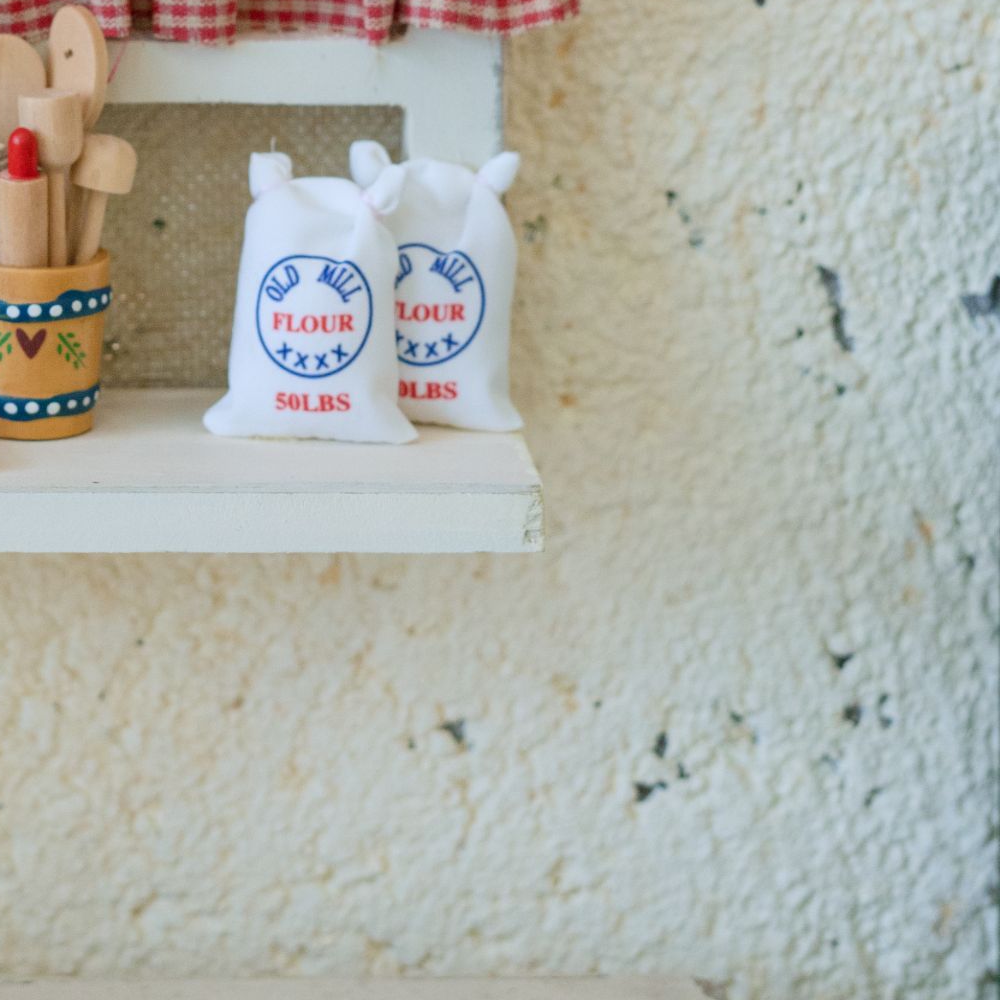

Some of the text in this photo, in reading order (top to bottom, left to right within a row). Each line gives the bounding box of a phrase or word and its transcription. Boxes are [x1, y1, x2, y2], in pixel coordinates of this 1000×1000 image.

[265, 264, 300, 302] OLD
[317, 263, 362, 303] MILL
[429, 256, 474, 293] MILL
[272, 311, 354, 333] FLOUR
[395, 300, 465, 323] LOUR
[398, 379, 458, 400] 0LBS
[275, 391, 351, 412] 50LBS
